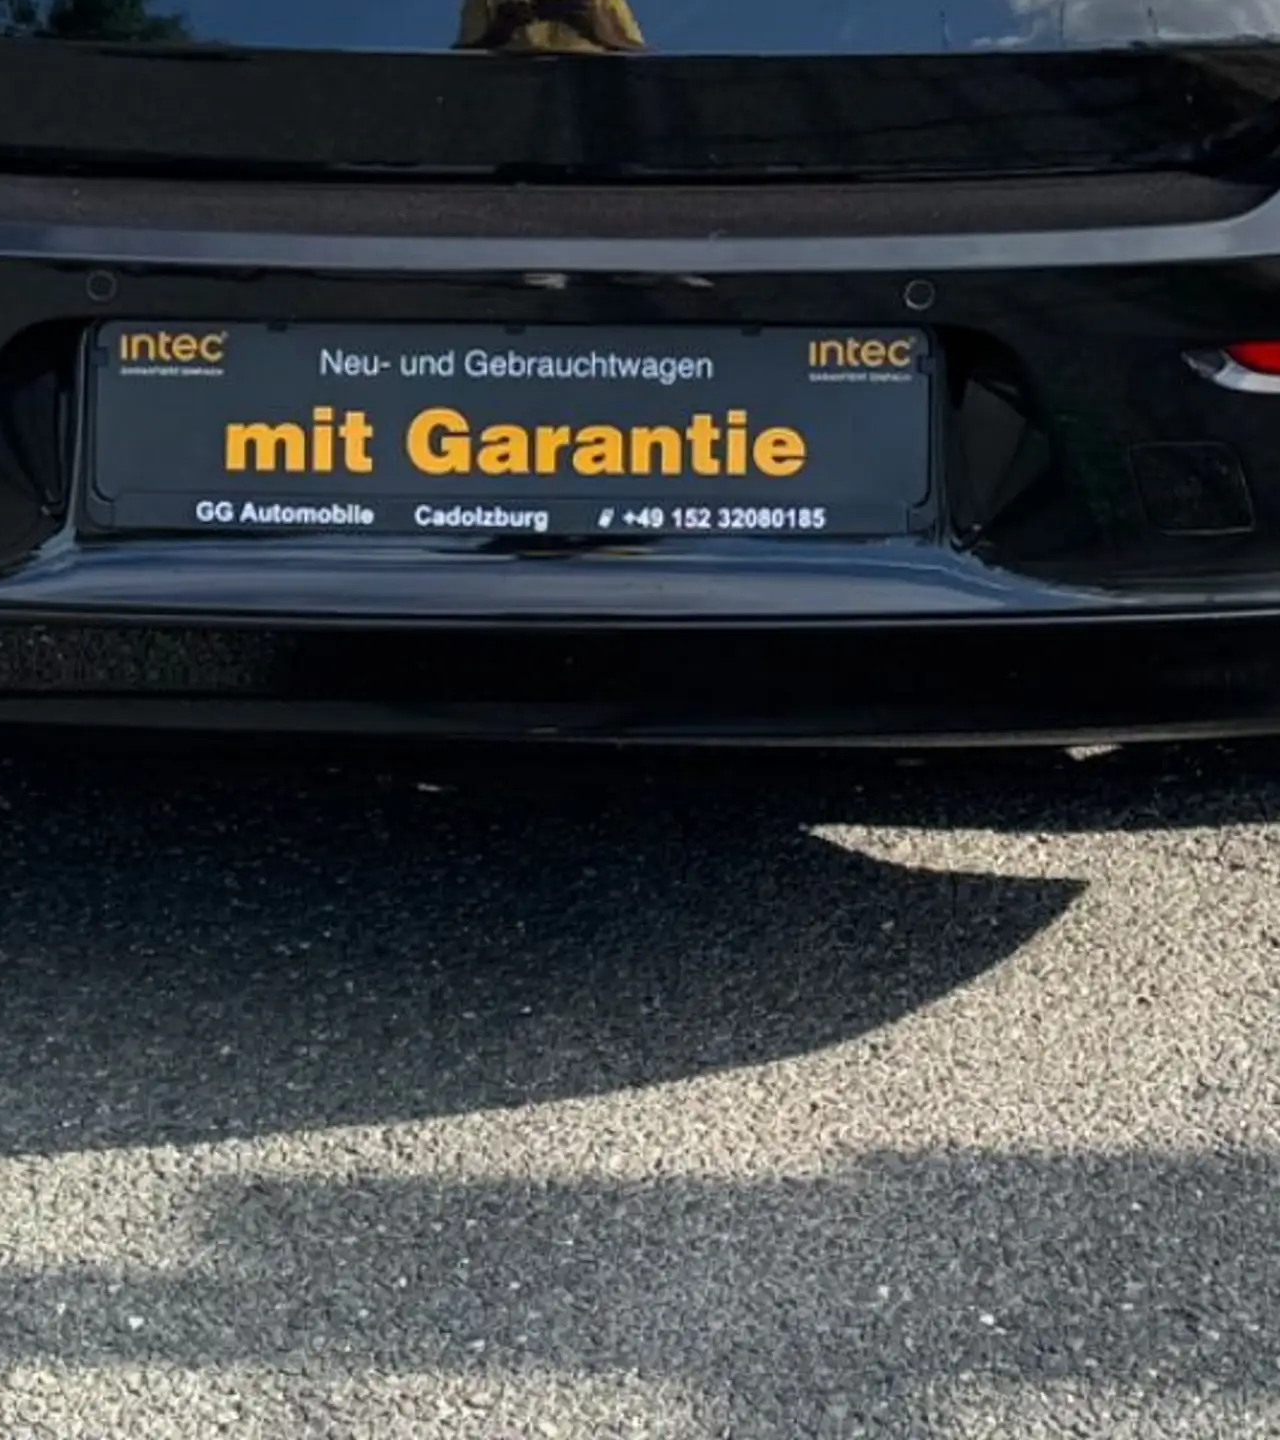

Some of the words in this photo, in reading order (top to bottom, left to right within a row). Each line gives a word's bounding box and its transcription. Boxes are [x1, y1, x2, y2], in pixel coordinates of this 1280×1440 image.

[120, 331, 228, 361] intec
[809, 337, 915, 367] intec
[320, 349, 390, 375] Neu-
[400, 350, 455, 377] und
[464, 349, 714, 385] Gebrauchtwagen
[225, 406, 373, 472] mit
[406, 407, 807, 477] Garantie
[195, 501, 234, 522] GG
[240, 502, 374, 525] Automobile
[414, 505, 549, 532] Cadolzburg
[622, 507, 664, 527] +49
[671, 508, 711, 528] 152
[717, 507, 826, 528] 32080185
